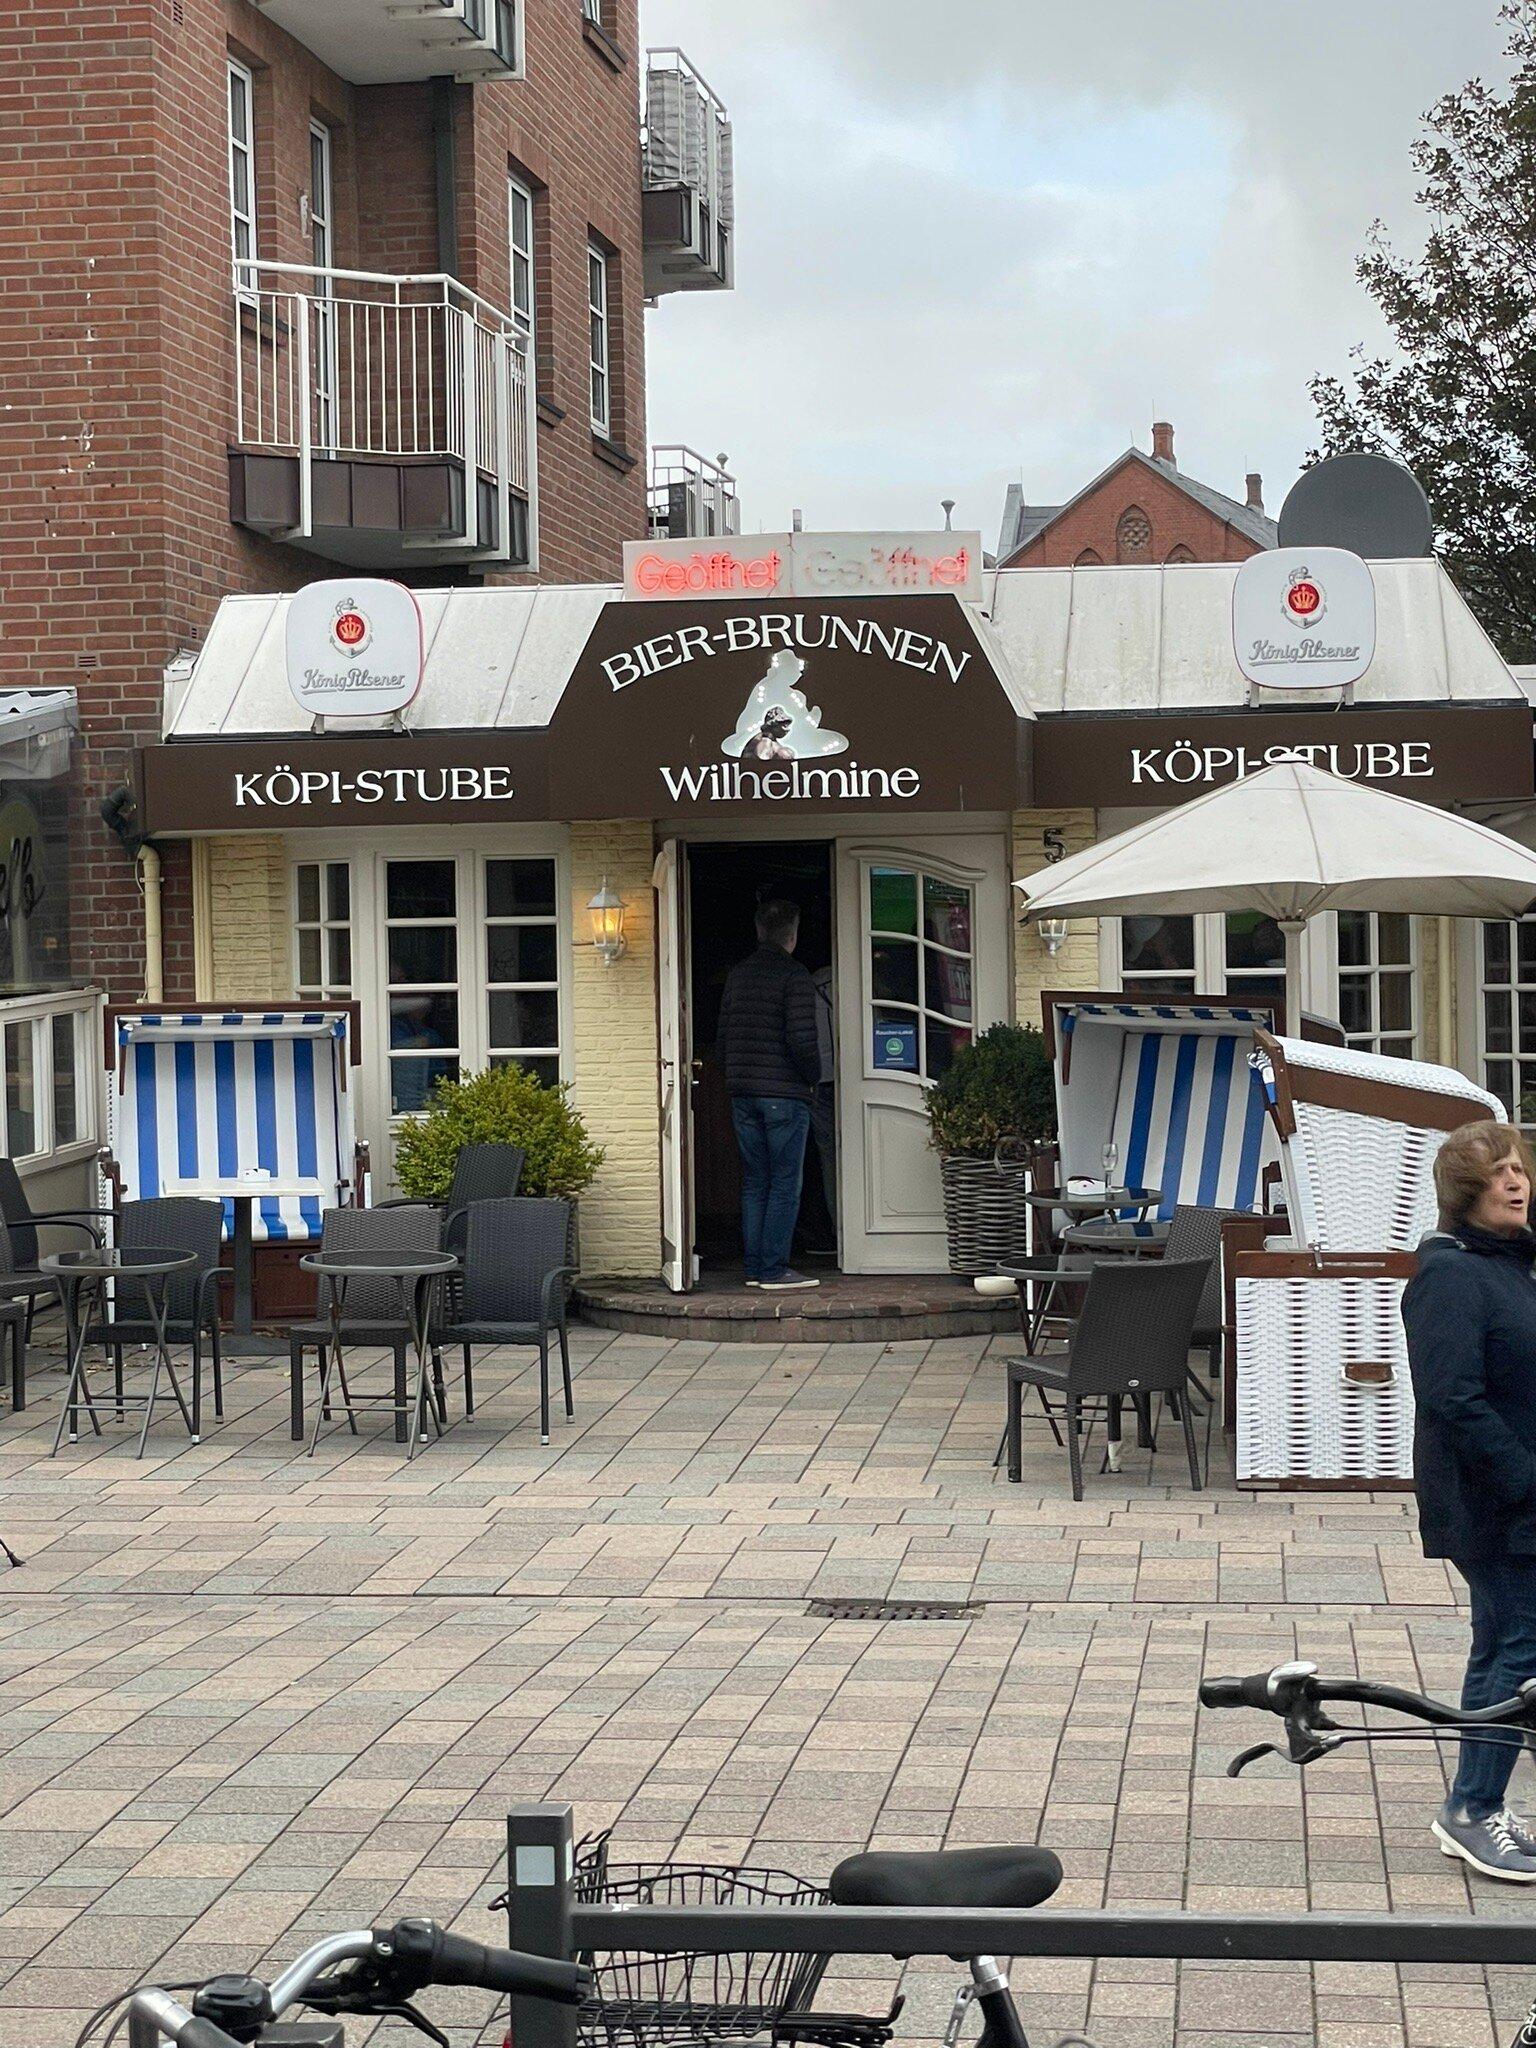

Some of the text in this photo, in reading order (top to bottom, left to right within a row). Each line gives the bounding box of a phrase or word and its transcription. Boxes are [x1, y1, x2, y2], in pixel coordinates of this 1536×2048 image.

[635, 549, 781, 592] Geöffnet
[600, 614, 972, 692] BIER-BRUNNEN
[1249, 640, 1300, 663] König
[300, 668, 348, 692] König
[235, 765, 514, 806] KÖPI-STUBE
[659, 761, 920, 802] Wilhelmine
[1043, 828, 1067, 863] 5
